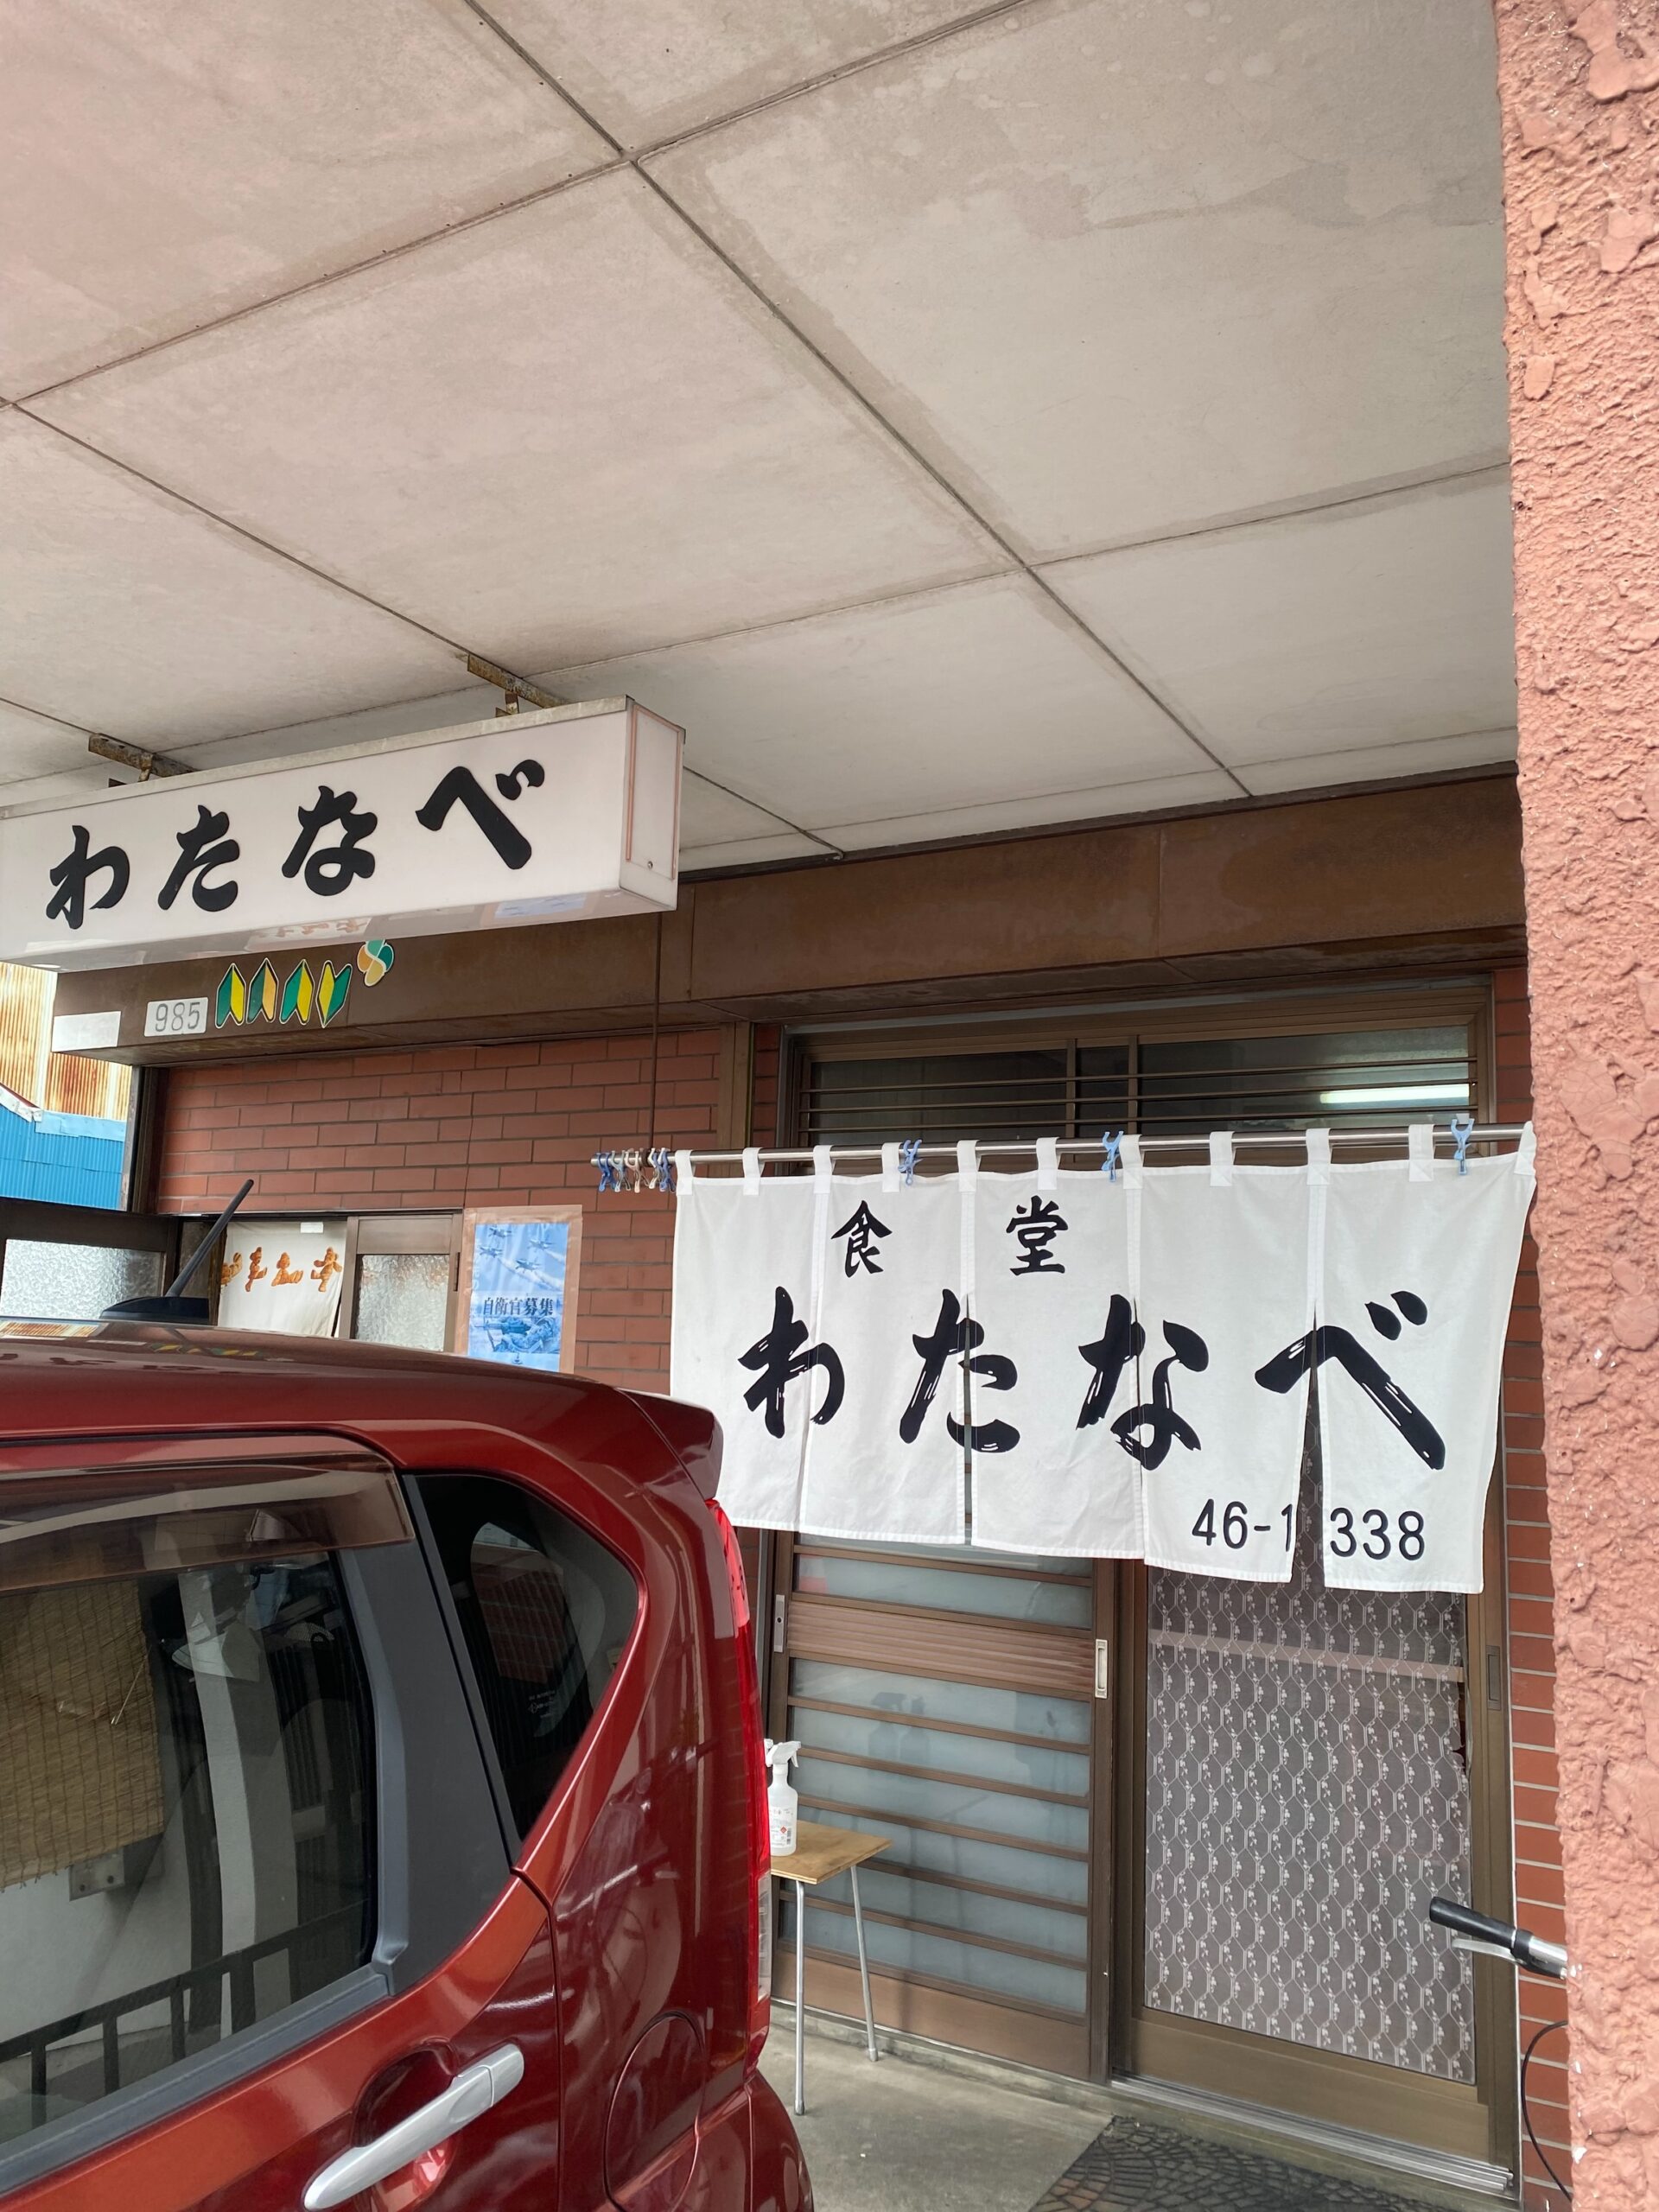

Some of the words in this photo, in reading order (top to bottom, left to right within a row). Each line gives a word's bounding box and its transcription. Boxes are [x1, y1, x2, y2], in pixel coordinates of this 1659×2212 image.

[46, 759, 545, 930] わたなべ
[155, 1001, 200, 1032] 985
[830, 1196, 1069, 1277] 食堂
[483, 1297, 554, 1316] 自衛官募集
[737, 1286, 1446, 1471] わたなべ
